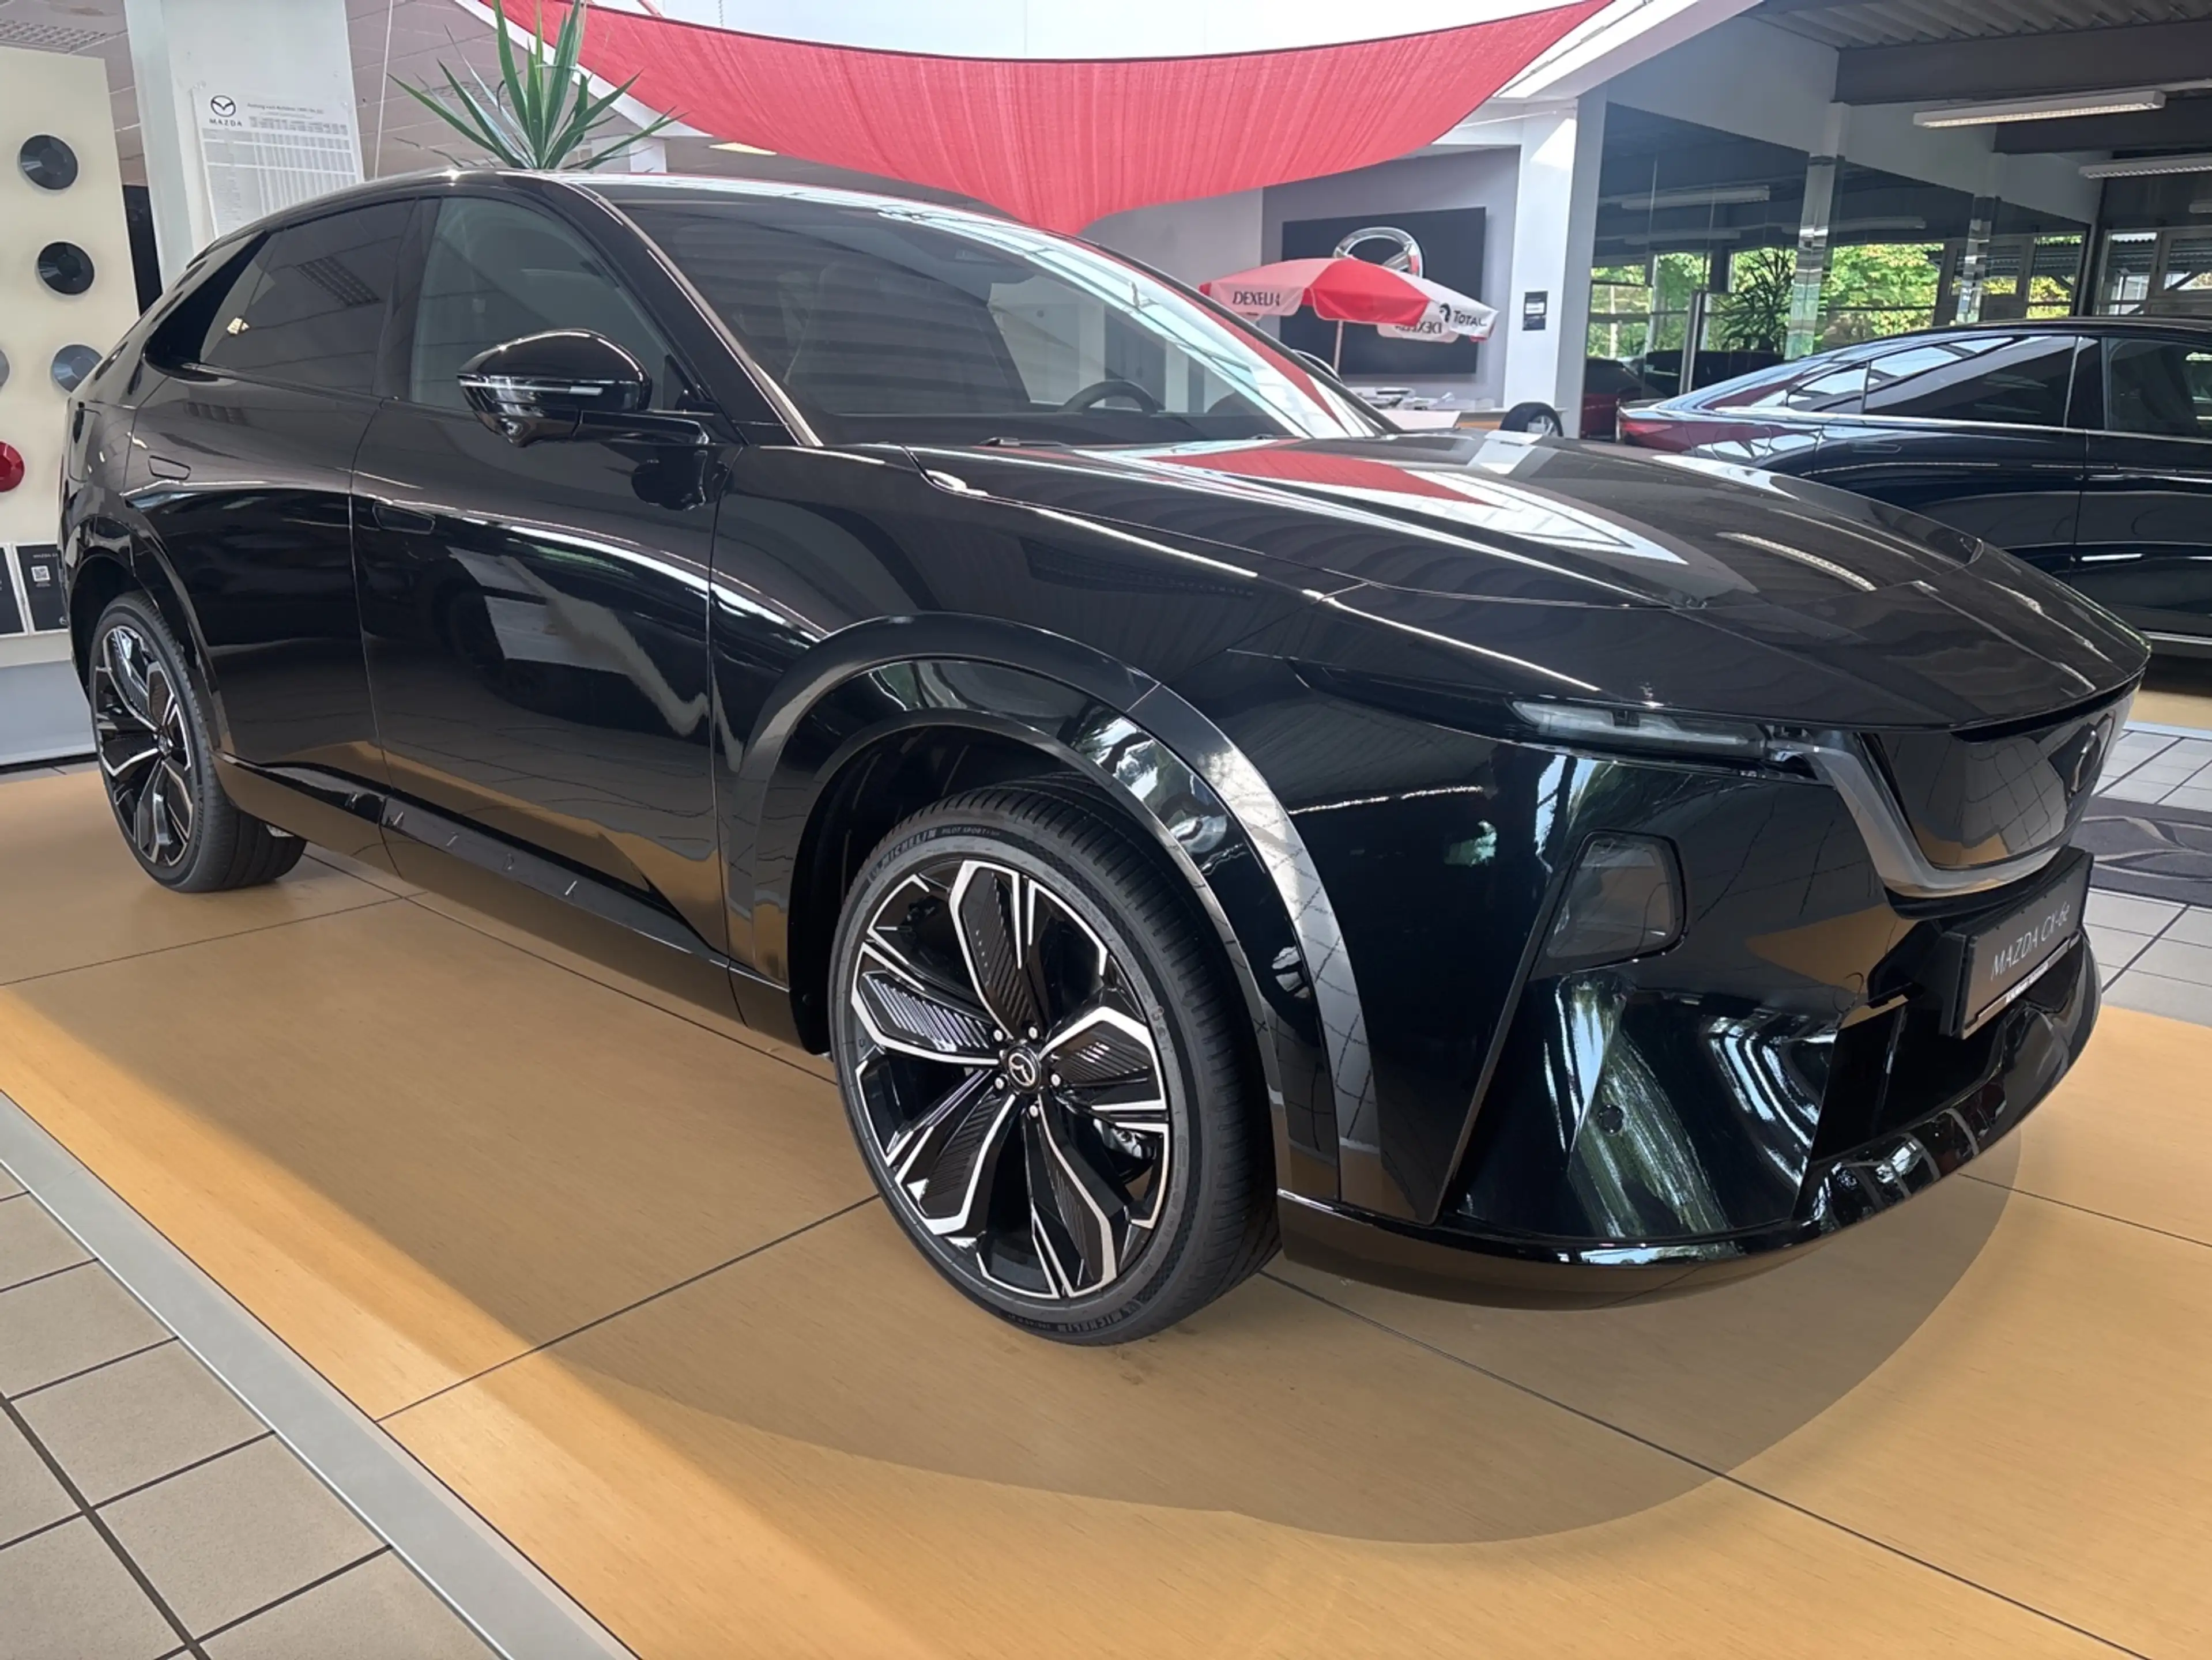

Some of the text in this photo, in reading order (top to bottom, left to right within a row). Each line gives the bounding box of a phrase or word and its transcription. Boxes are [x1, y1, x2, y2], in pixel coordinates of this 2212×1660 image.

[209, 118, 242, 127] MAZDA
[1453, 310, 1487, 326] TOTAL
[1990, 926, 2038, 982] MAZDA
